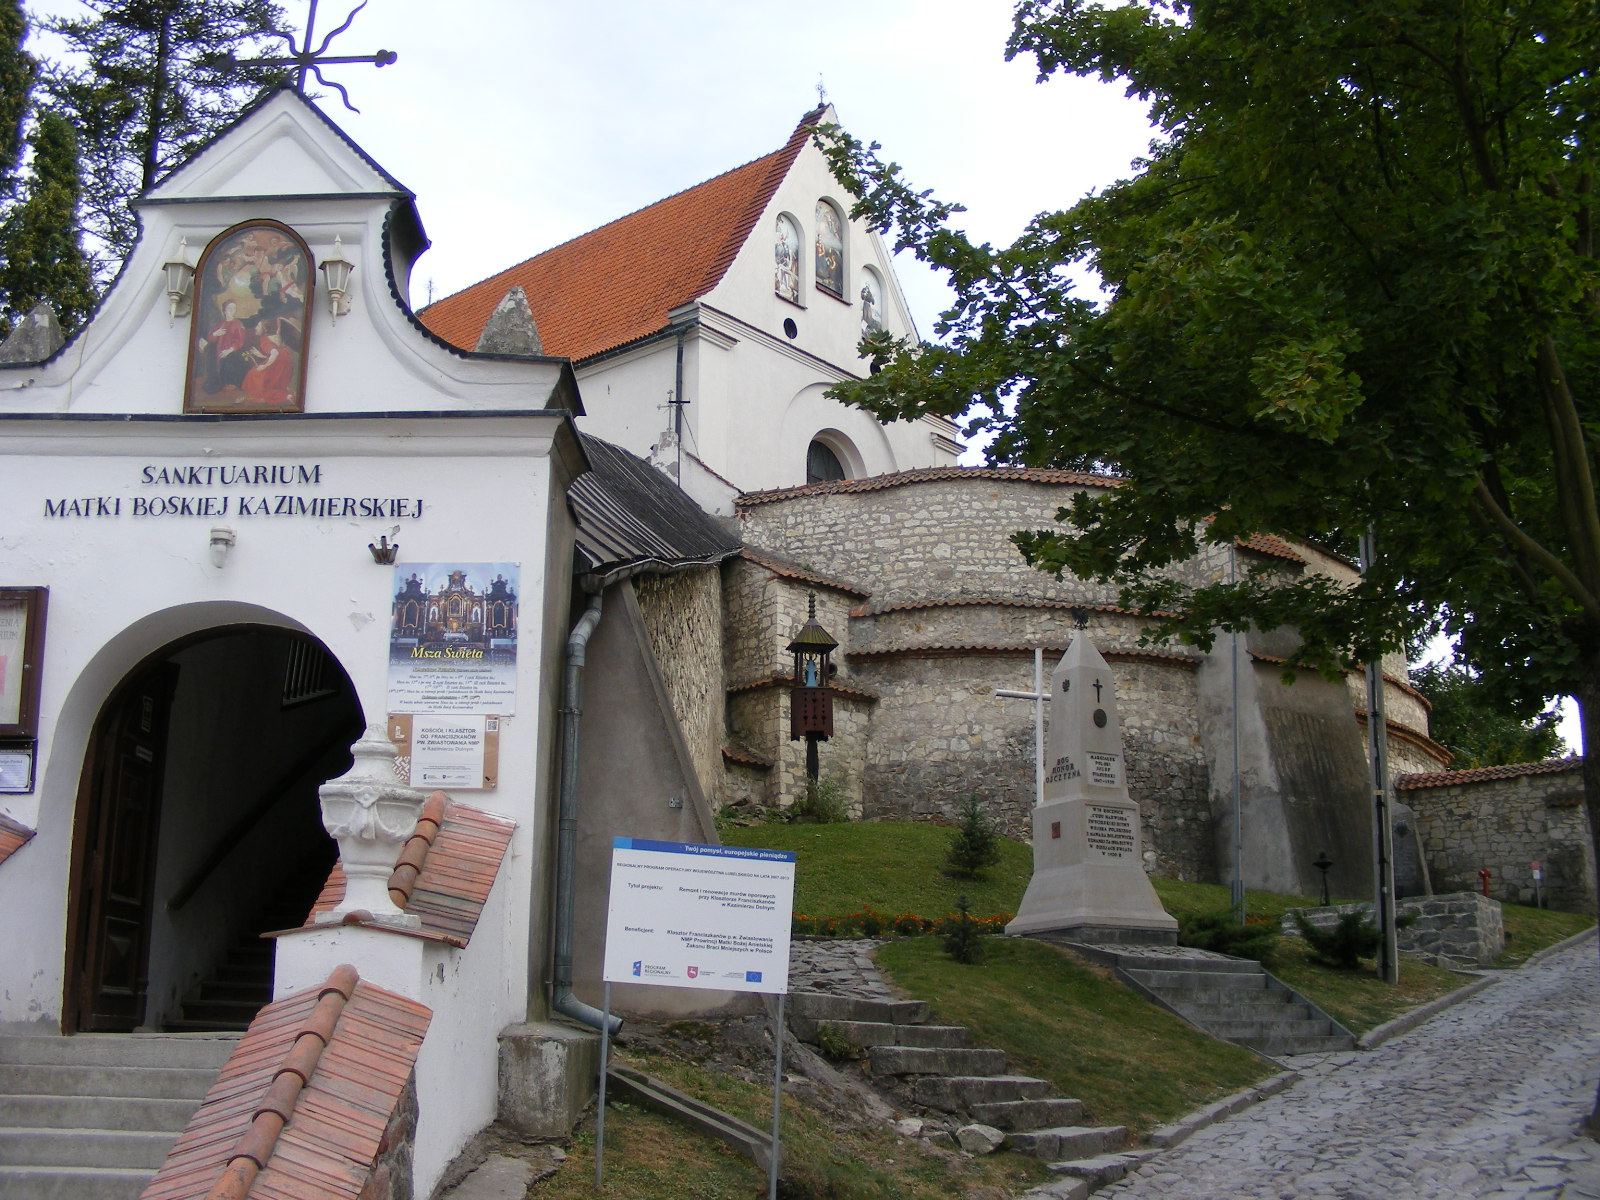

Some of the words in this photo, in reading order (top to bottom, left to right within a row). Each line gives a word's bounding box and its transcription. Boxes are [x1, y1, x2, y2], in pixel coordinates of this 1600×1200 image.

[140, 464, 321, 485] SANKTUARIUM
[44, 498, 120, 517] MATKI
[132, 496, 227, 517] BOSKIEJ
[238, 496, 423, 518] KAZIMIERSKIEJ
[411, 646, 441, 658] Msza
[444, 645, 483, 660] Święta
[1052, 763, 1074, 774] HONOR
[1046, 770, 1081, 783] OJCZYZNA
